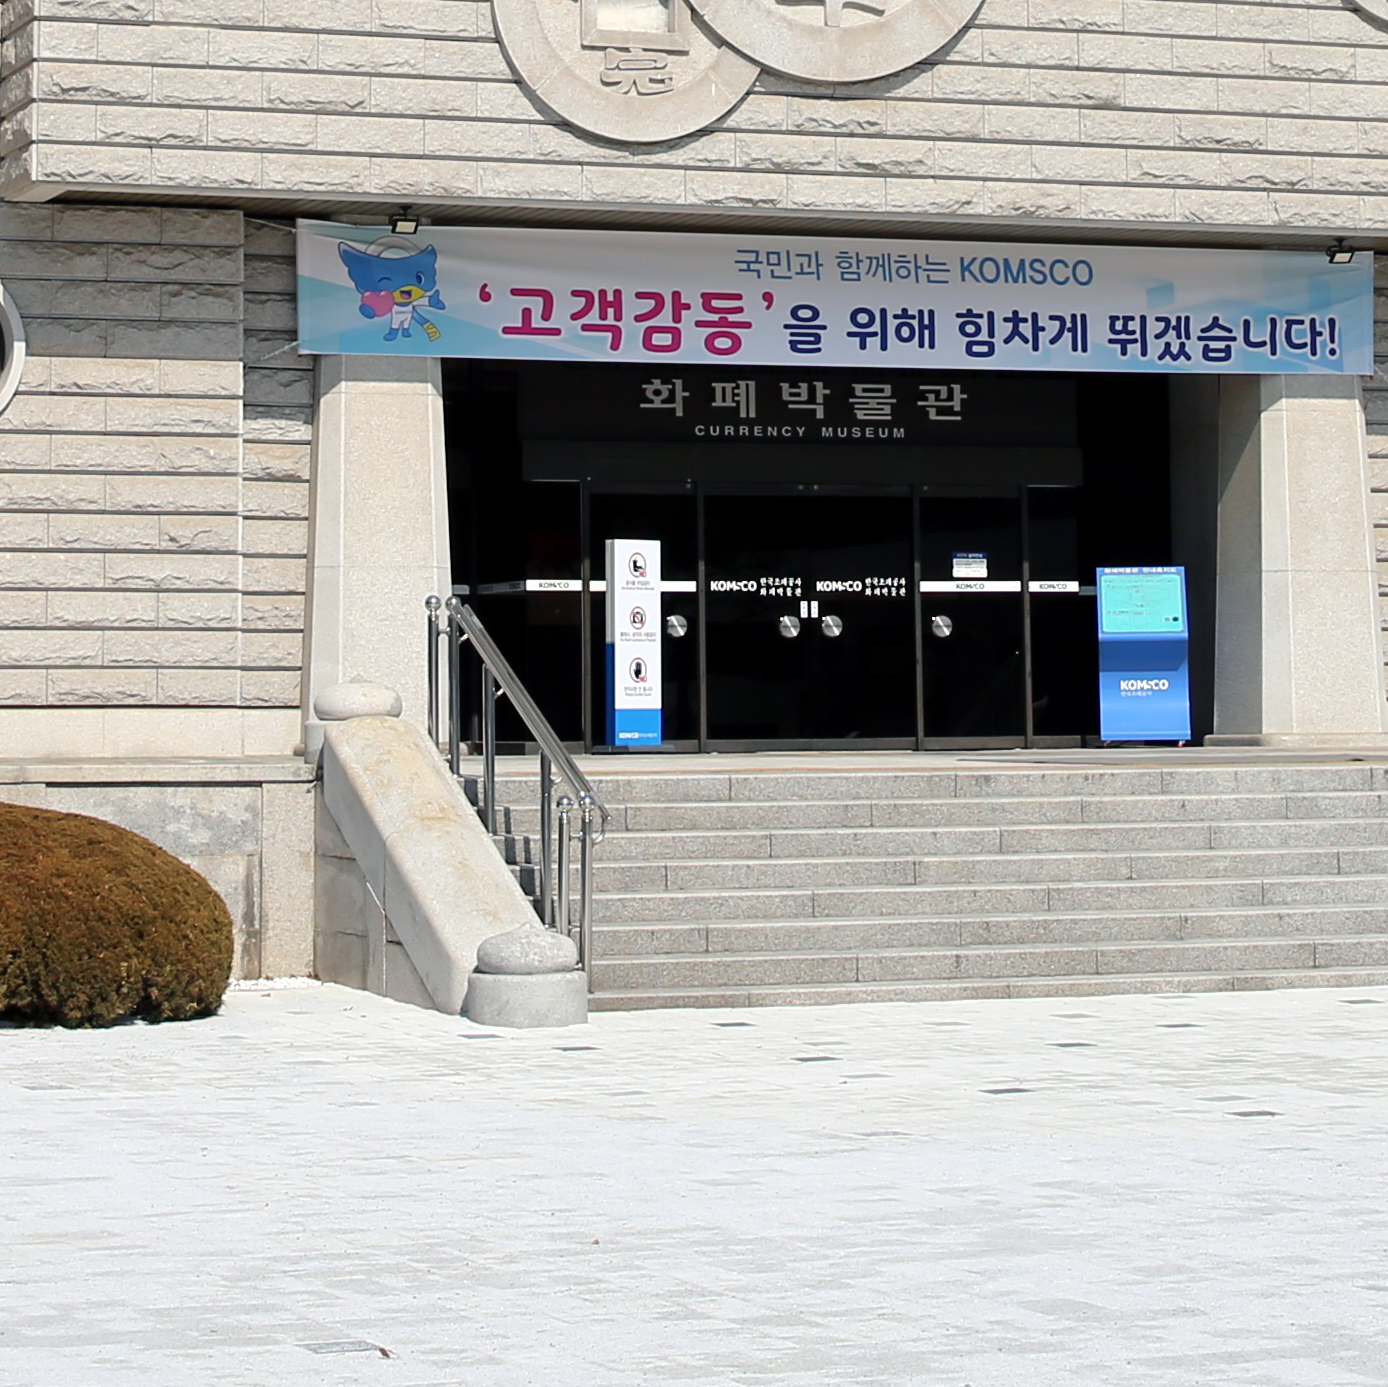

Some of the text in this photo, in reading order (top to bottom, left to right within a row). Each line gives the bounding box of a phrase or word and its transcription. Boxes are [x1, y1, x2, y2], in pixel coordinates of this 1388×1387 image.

[733, 248, 1095, 287] 국민과 함께하는 KOMSCO
[845, 306, 936, 352] 위해
[954, 307, 1090, 359] 힘차게
[1106, 314, 1340, 363] 뛰겠습니다!
[639, 378, 968, 422] 화폐박물관
[694, 424, 906, 439] CURRENCY MUSEUM
[1120, 678, 1170, 691] KOMSCO
